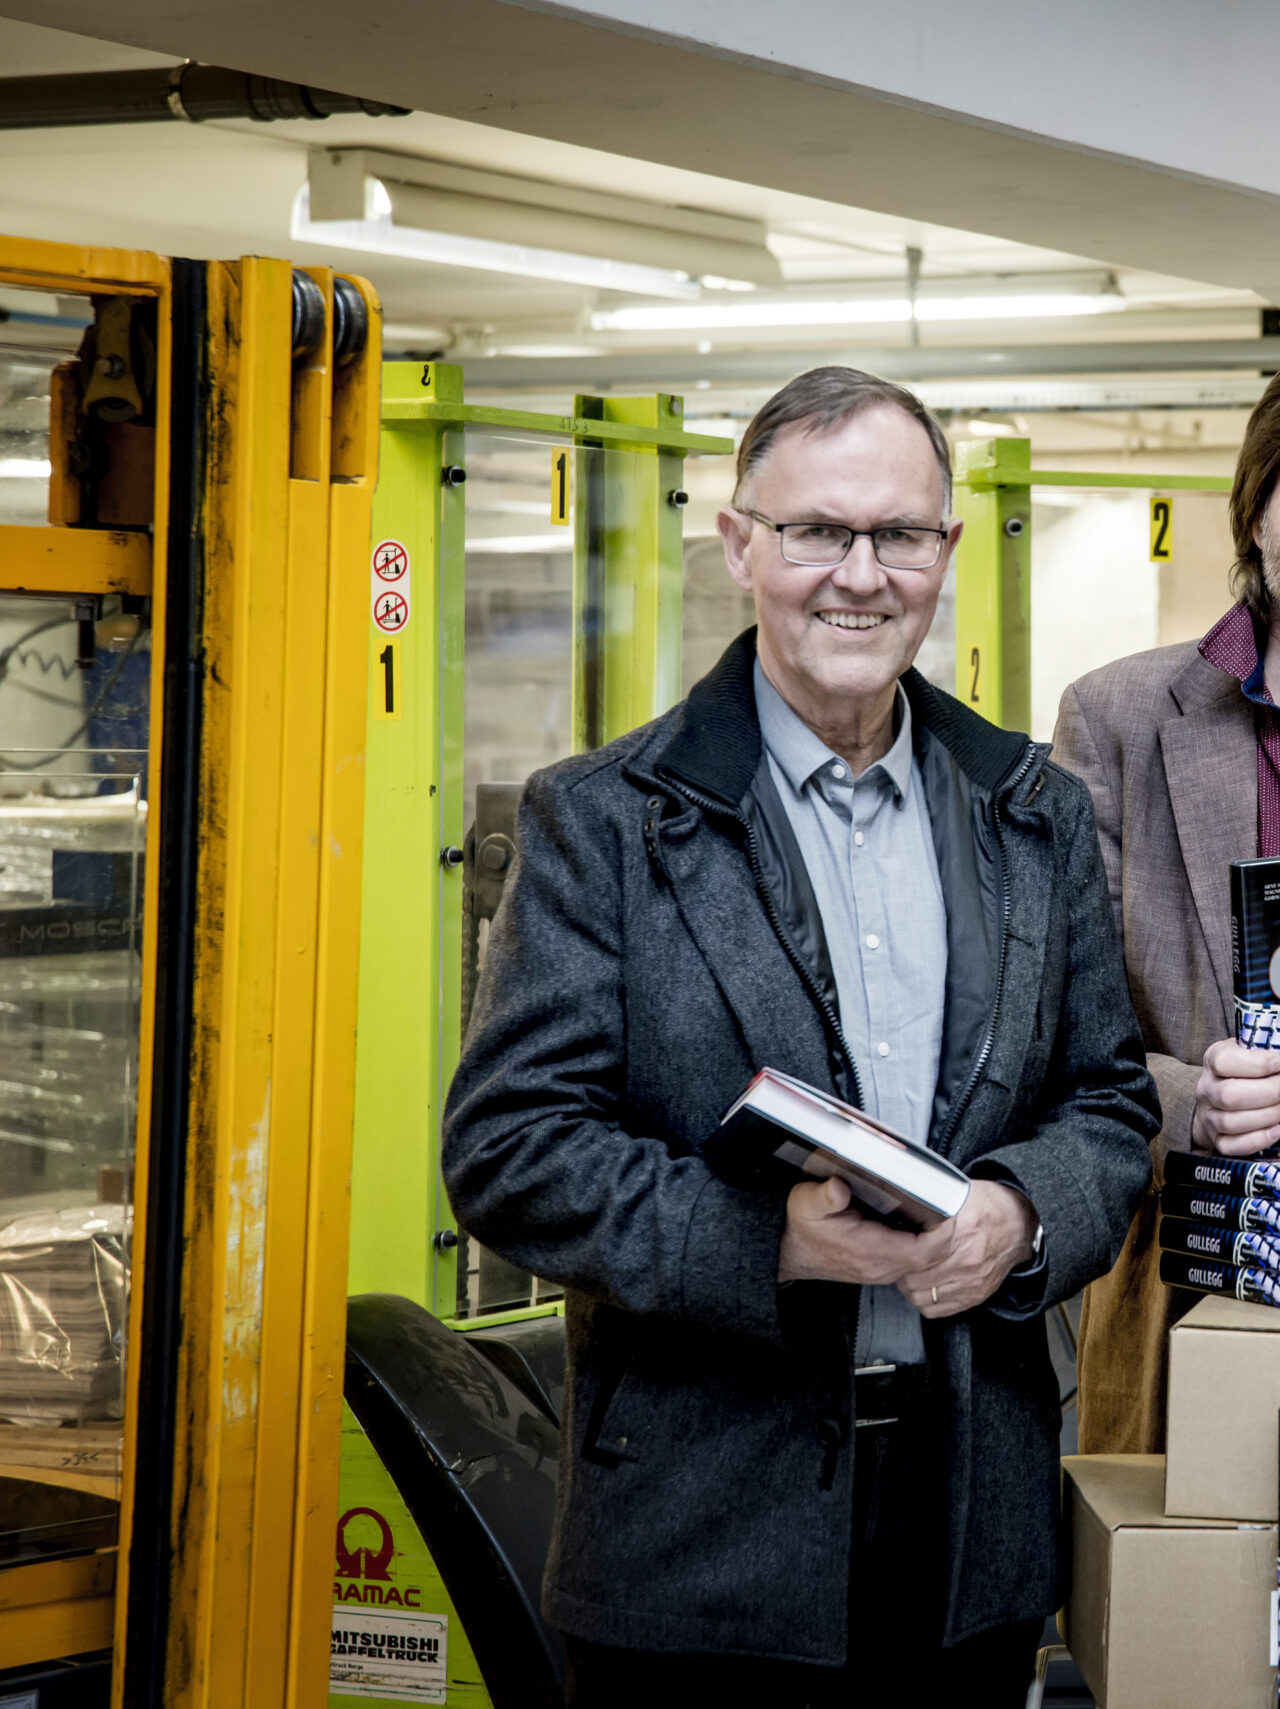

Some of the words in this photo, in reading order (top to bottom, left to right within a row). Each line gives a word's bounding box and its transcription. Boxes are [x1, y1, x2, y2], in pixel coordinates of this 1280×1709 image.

[556, 453, 566, 519] 1
[1153, 502, 1169, 557] 2
[380, 645, 394, 713] 1
[971, 647, 980, 702] 2
[1231, 915, 1241, 974] GULLEGG
[1195, 1166, 1231, 1185] GULLEGG
[1190, 1200, 1225, 1219] GULLEGG
[1187, 1234, 1220, 1253] GULLEGG
[1188, 1268, 1223, 1288] GULLEGG
